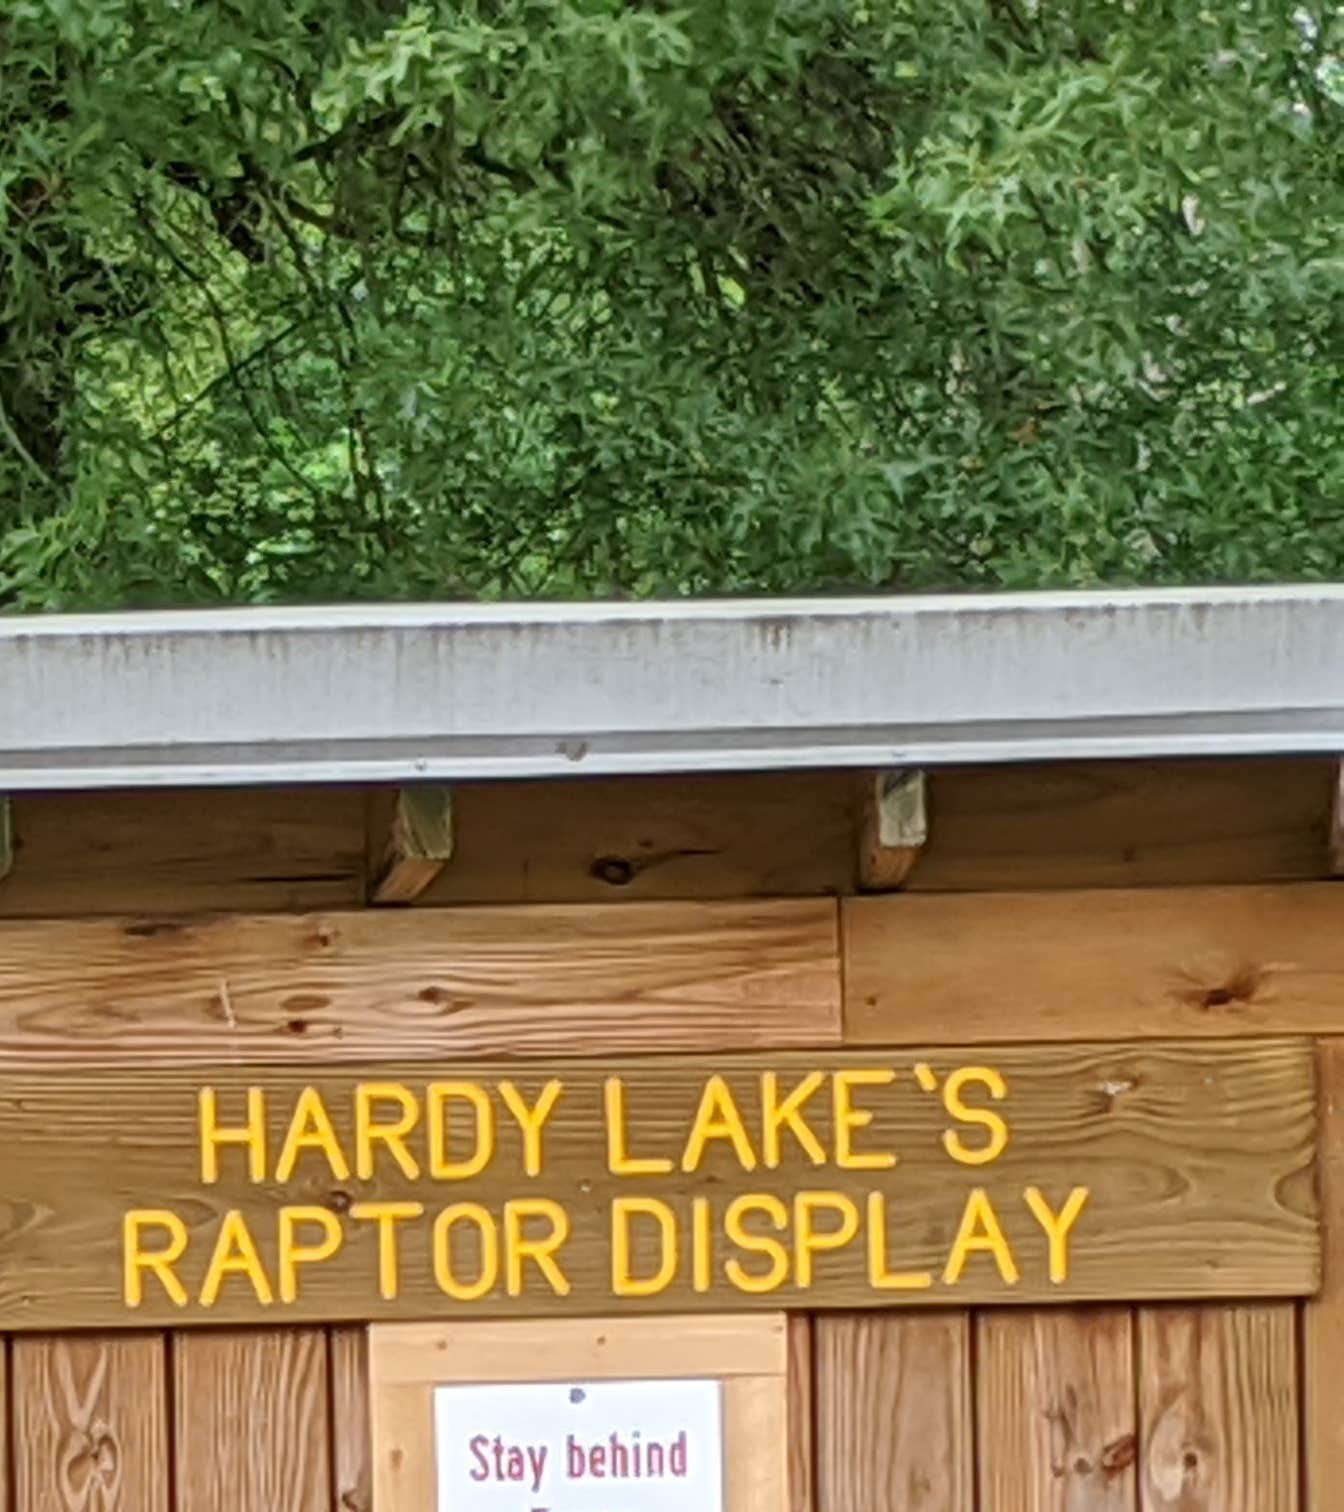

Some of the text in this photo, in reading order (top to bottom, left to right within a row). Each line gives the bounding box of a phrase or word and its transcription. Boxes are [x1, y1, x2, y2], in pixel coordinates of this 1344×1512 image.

[197, 1064, 1010, 1183] HARDY LAKE'S
[120, 1184, 1089, 1308] RAPTOR DISPLAY
[468, 1431, 687, 1492] Stay behind
